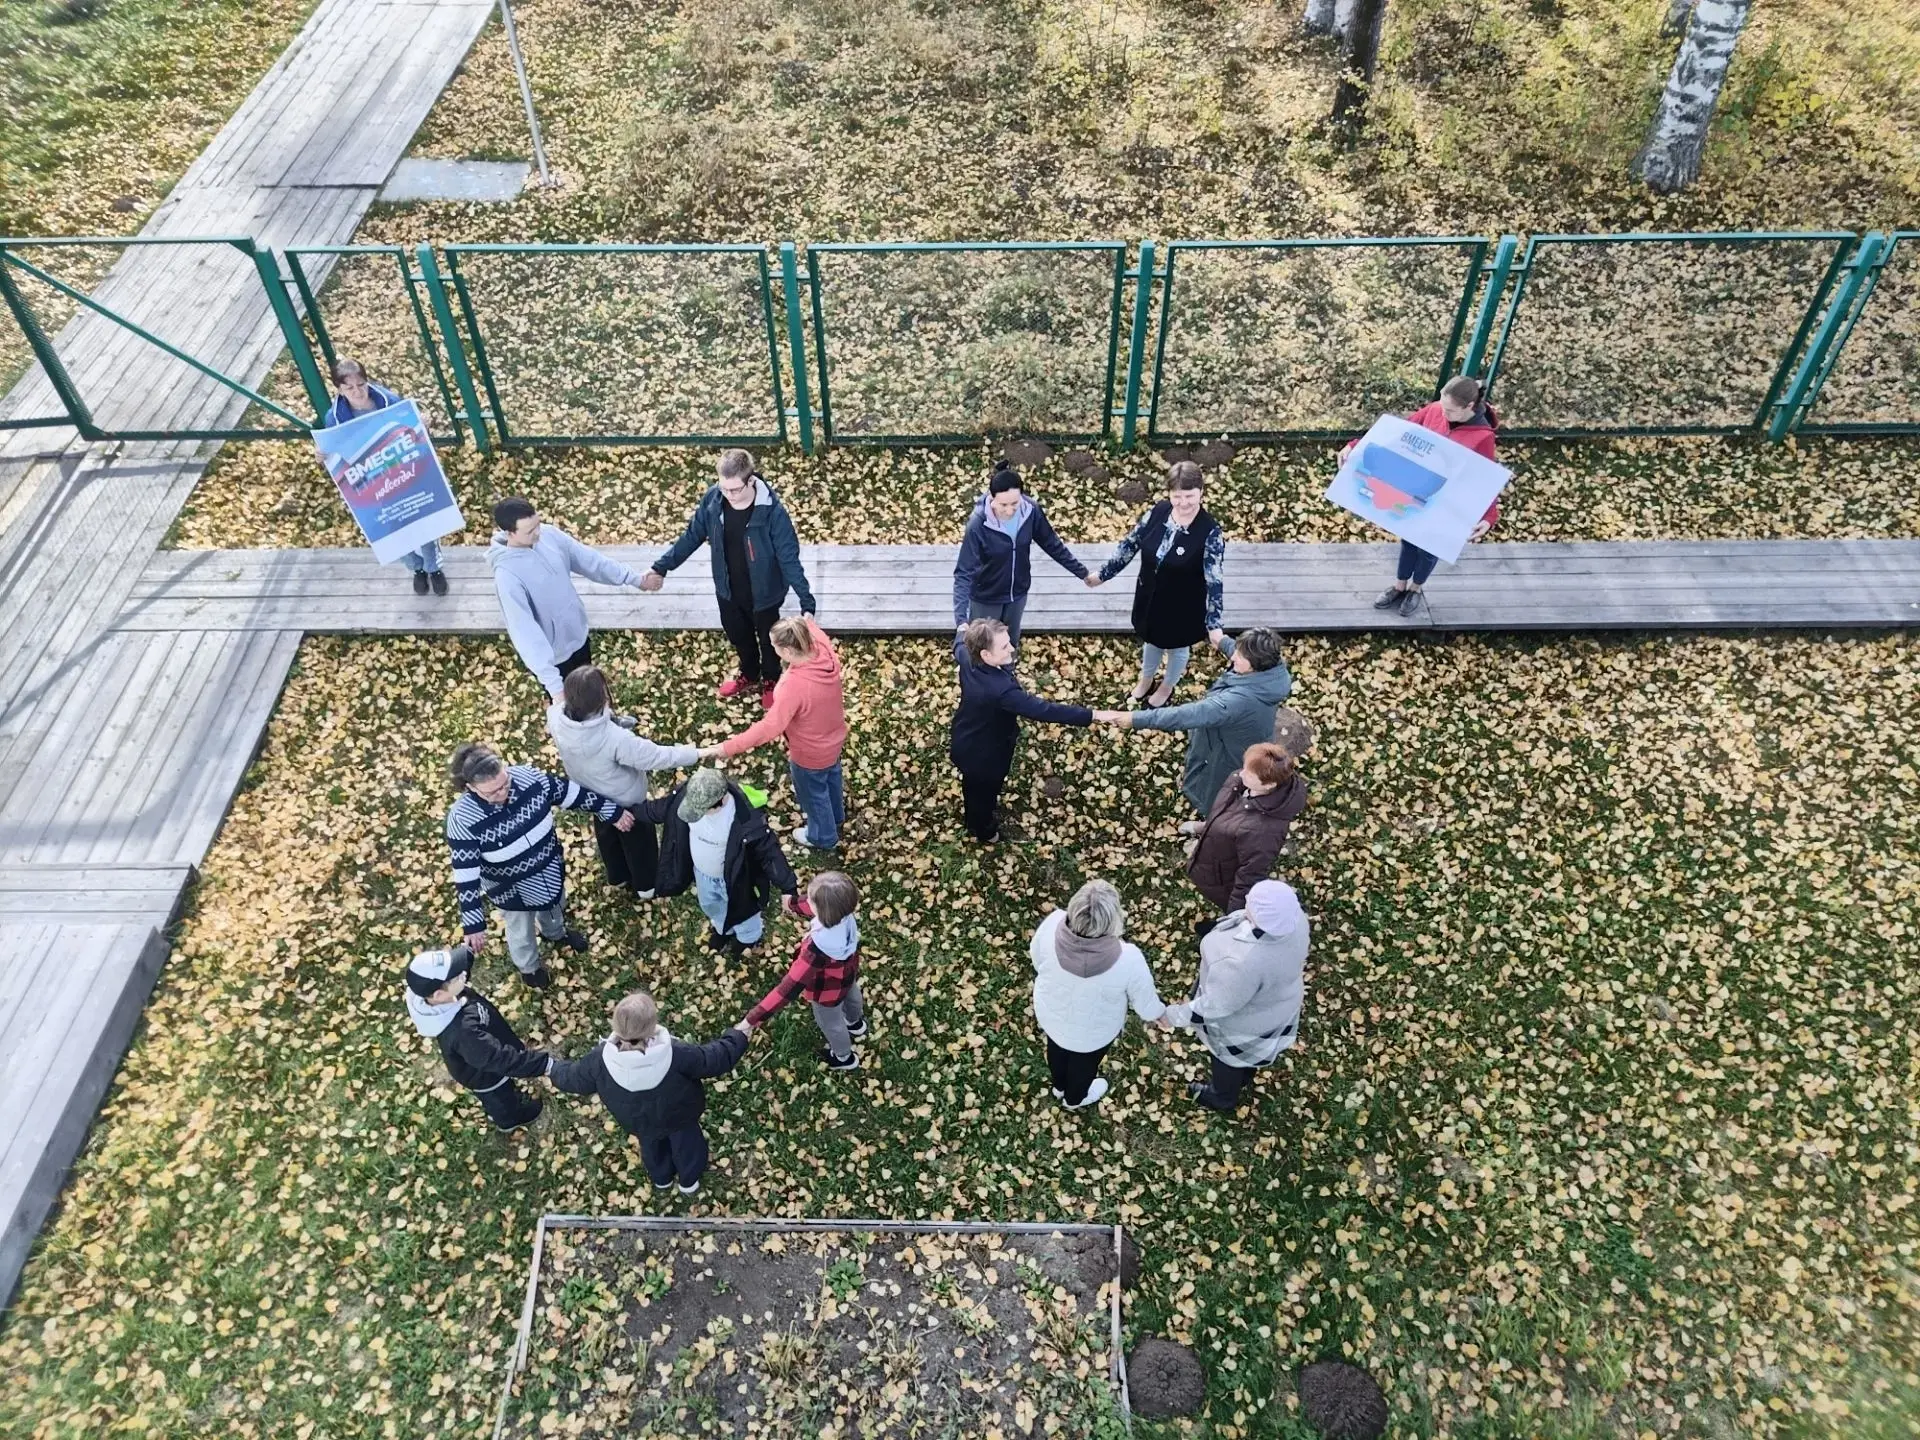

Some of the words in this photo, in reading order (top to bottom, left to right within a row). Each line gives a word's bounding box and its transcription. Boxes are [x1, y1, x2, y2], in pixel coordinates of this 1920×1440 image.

[344, 432, 416, 485] ВМЕСТЕ
[1401, 431, 1436, 455] ВМЕСТЕ
[375, 462, 415, 501] навсегда!
